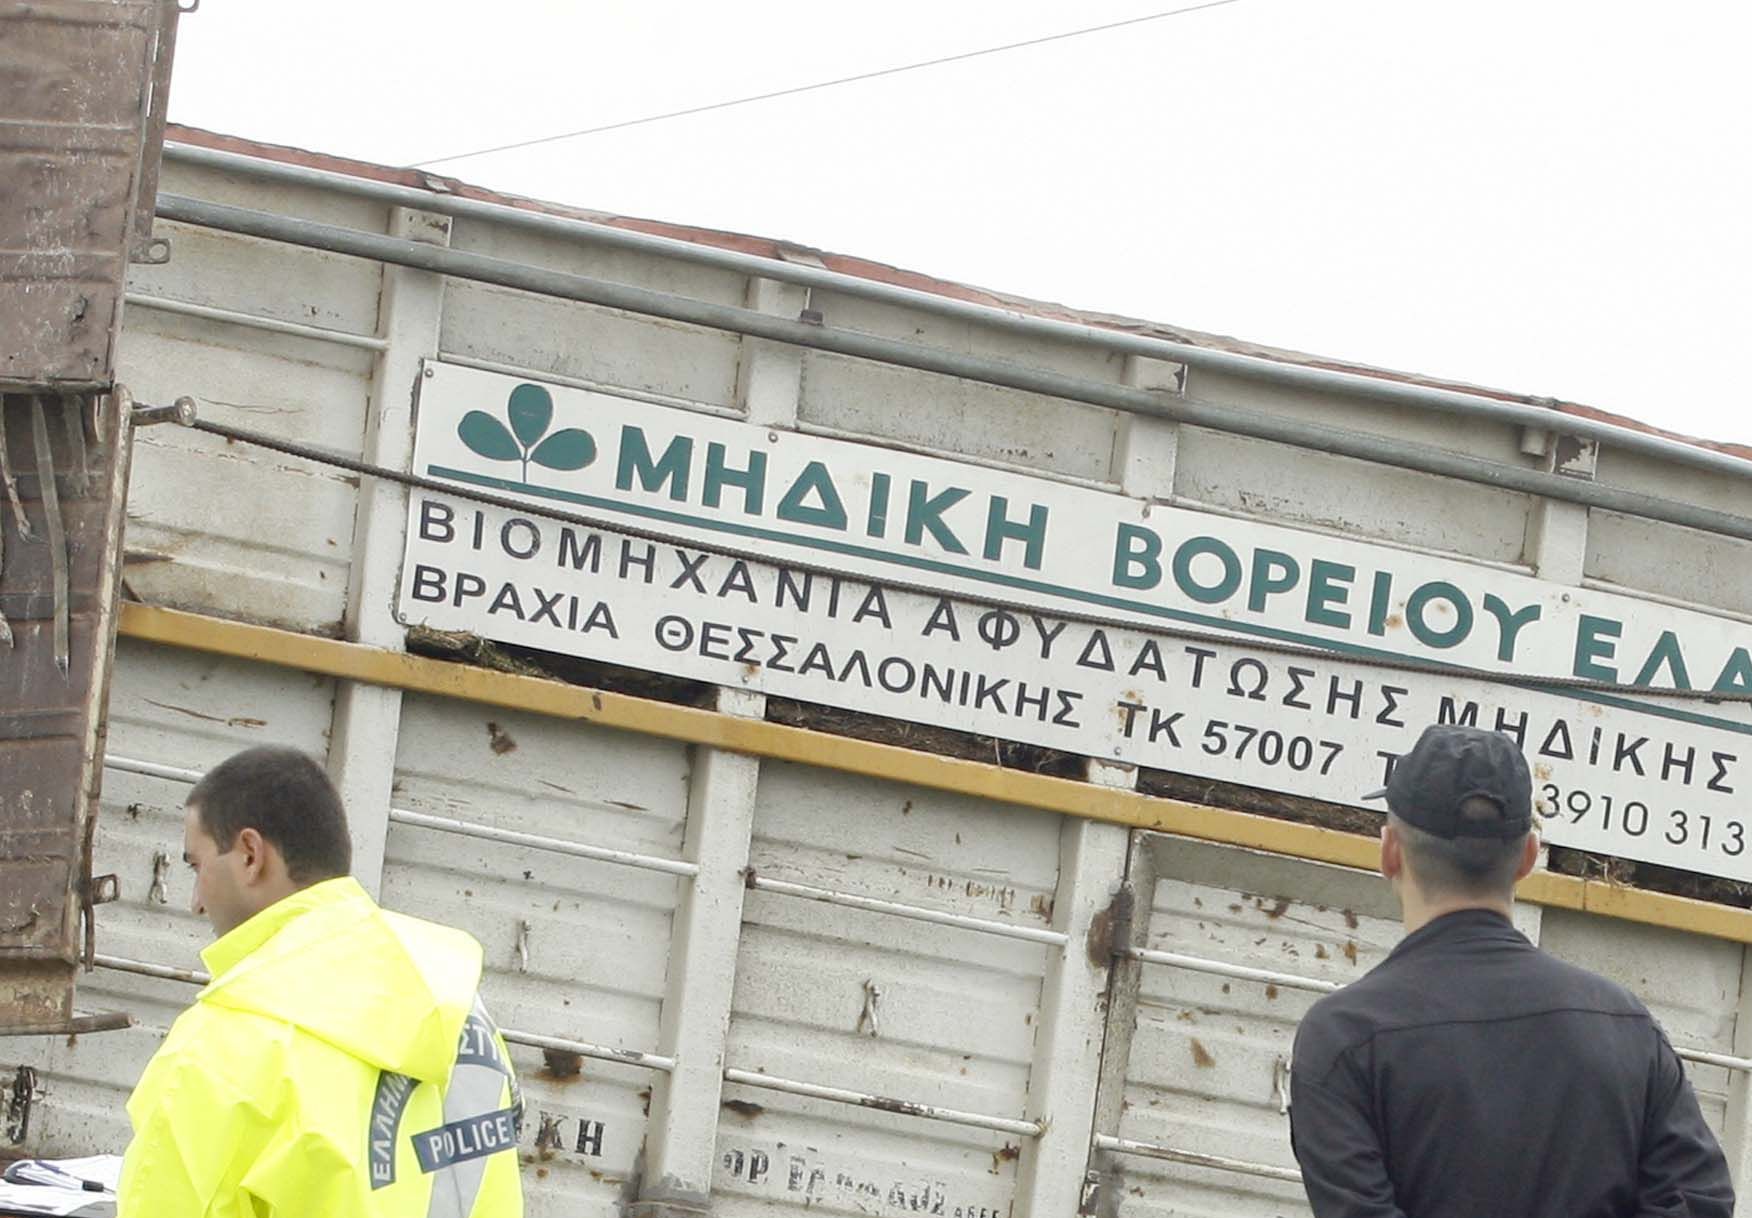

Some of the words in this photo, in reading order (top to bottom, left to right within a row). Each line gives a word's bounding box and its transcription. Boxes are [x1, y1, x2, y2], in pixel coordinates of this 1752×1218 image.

[418, 500, 892, 629] ΒΙΟΜΗΧΑΝΙΑ
[921, 597, 1409, 728] ΑΦΥΔΑΤΩΣΗΣ
[1437, 696, 1737, 794] ΜΗΔΙΚΗΣ
[616, 426, 1049, 570] ΜΗΔΙΚΗ
[1112, 522, 1541, 661] ΒΟΡΕΙΟΥ
[412, 565, 620, 639] ΒΡΑΧΙΑ
[655, 615, 1083, 728] ΘΕΣΣΑΛΟΝΙΚΗΣ
[1117, 701, 1185, 748] ΤΚ
[1201, 720, 1344, 775] 57007
[430, 1116, 510, 1163] POLICE
